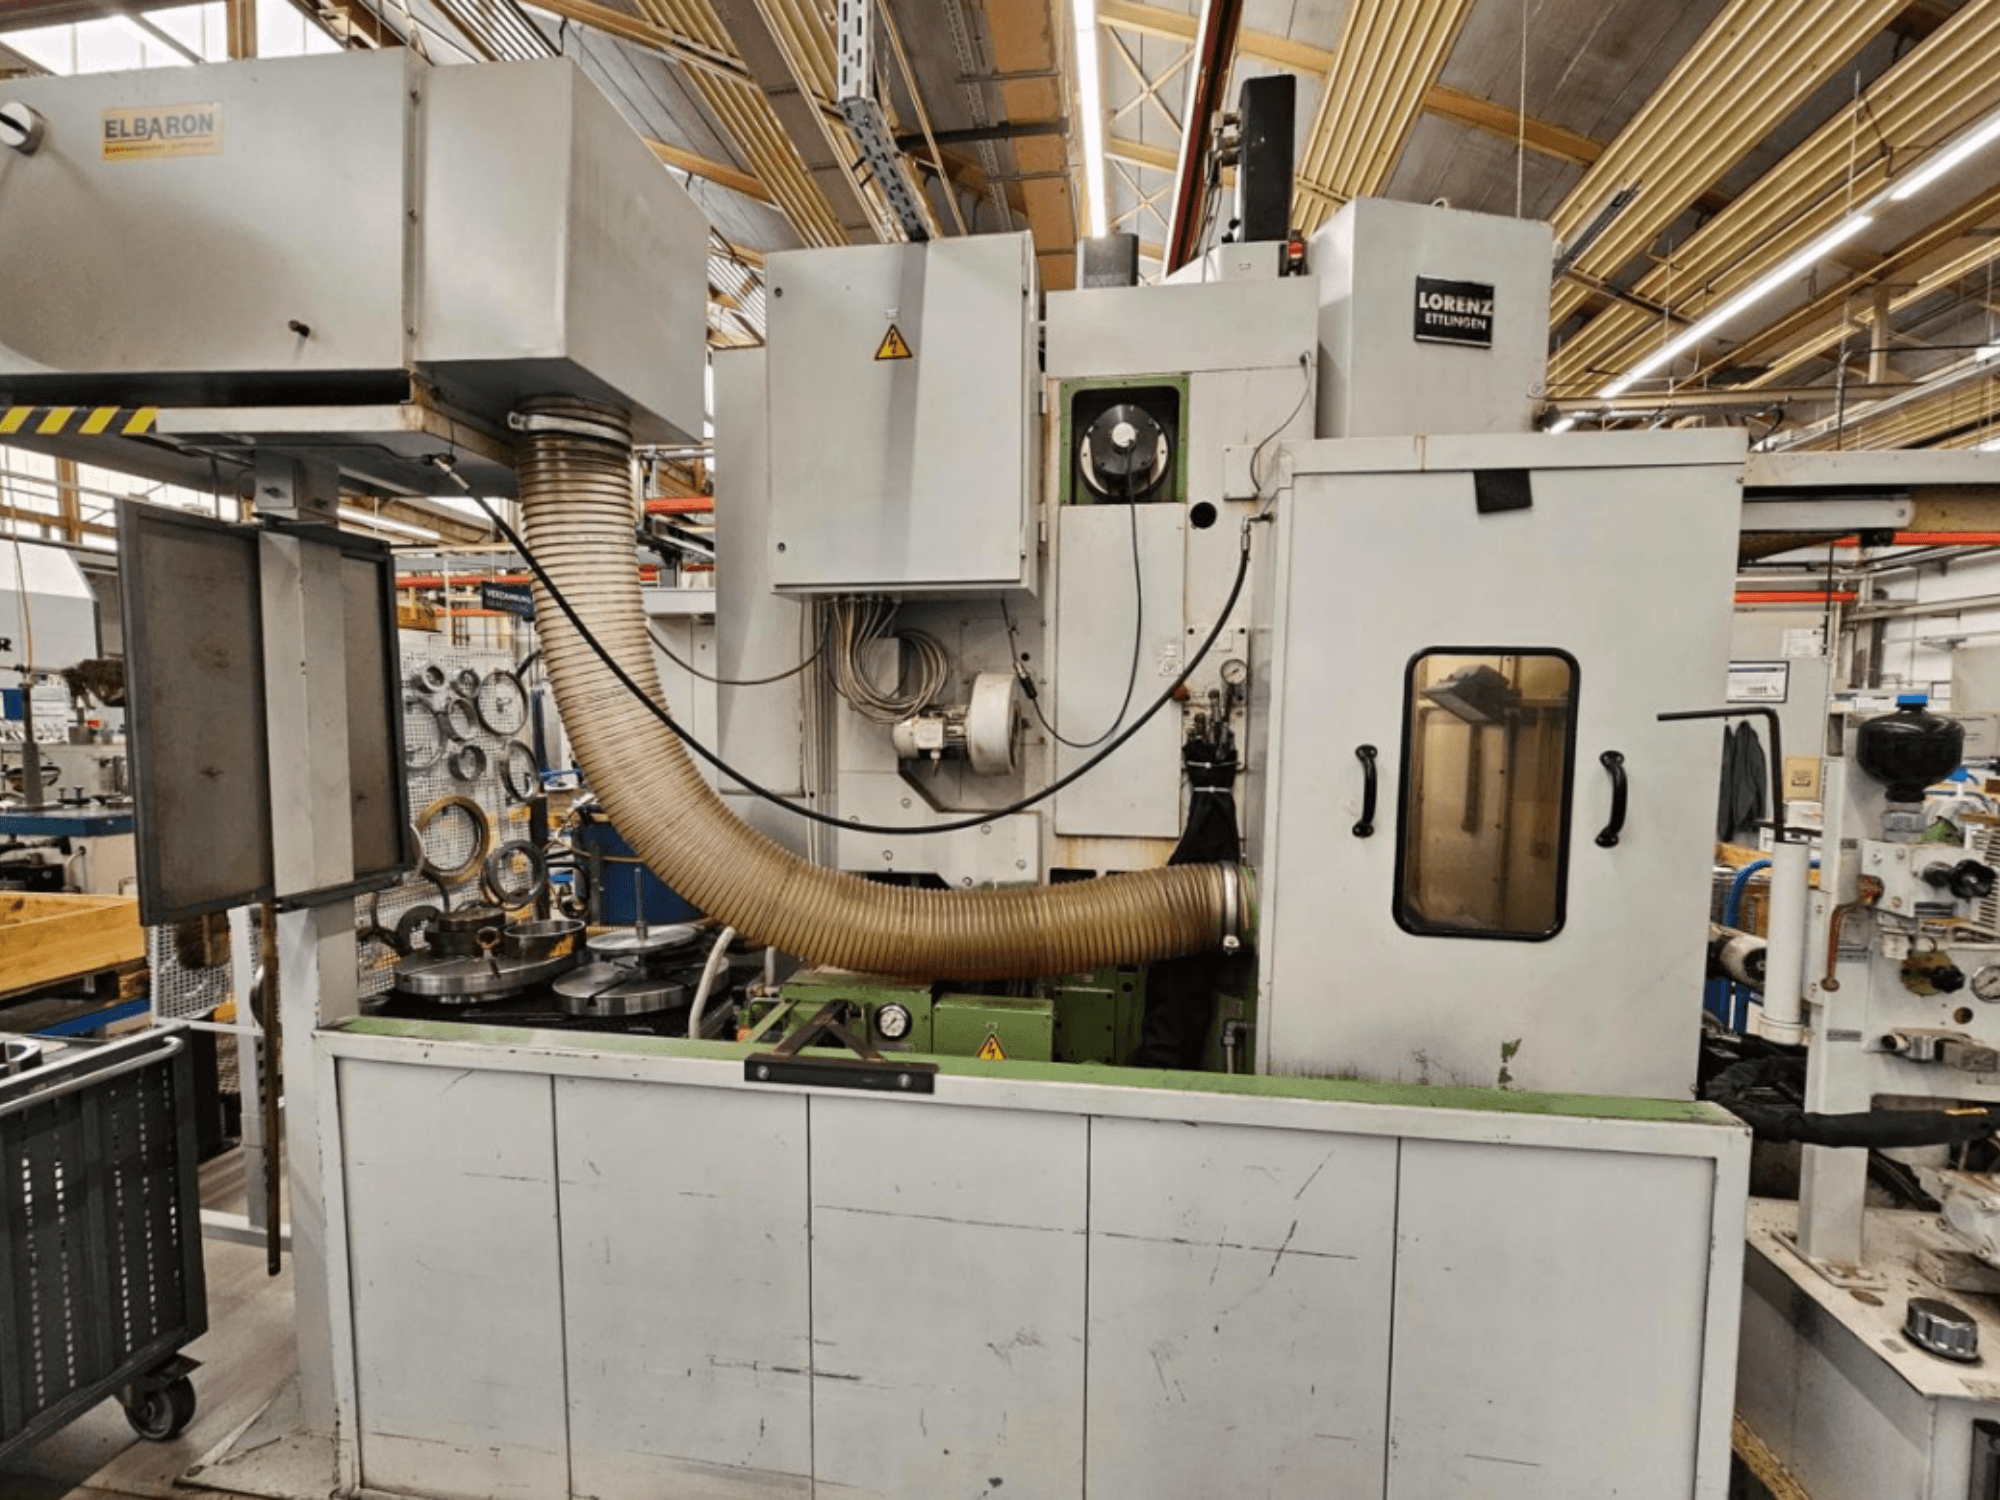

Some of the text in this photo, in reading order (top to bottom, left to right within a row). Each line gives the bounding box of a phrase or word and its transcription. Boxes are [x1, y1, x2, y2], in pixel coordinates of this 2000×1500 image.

[105, 113, 214, 140] ELBARON
[1419, 292, 1493, 316] LORENZ
[1425, 312, 1486, 330] ETTLINGEN
